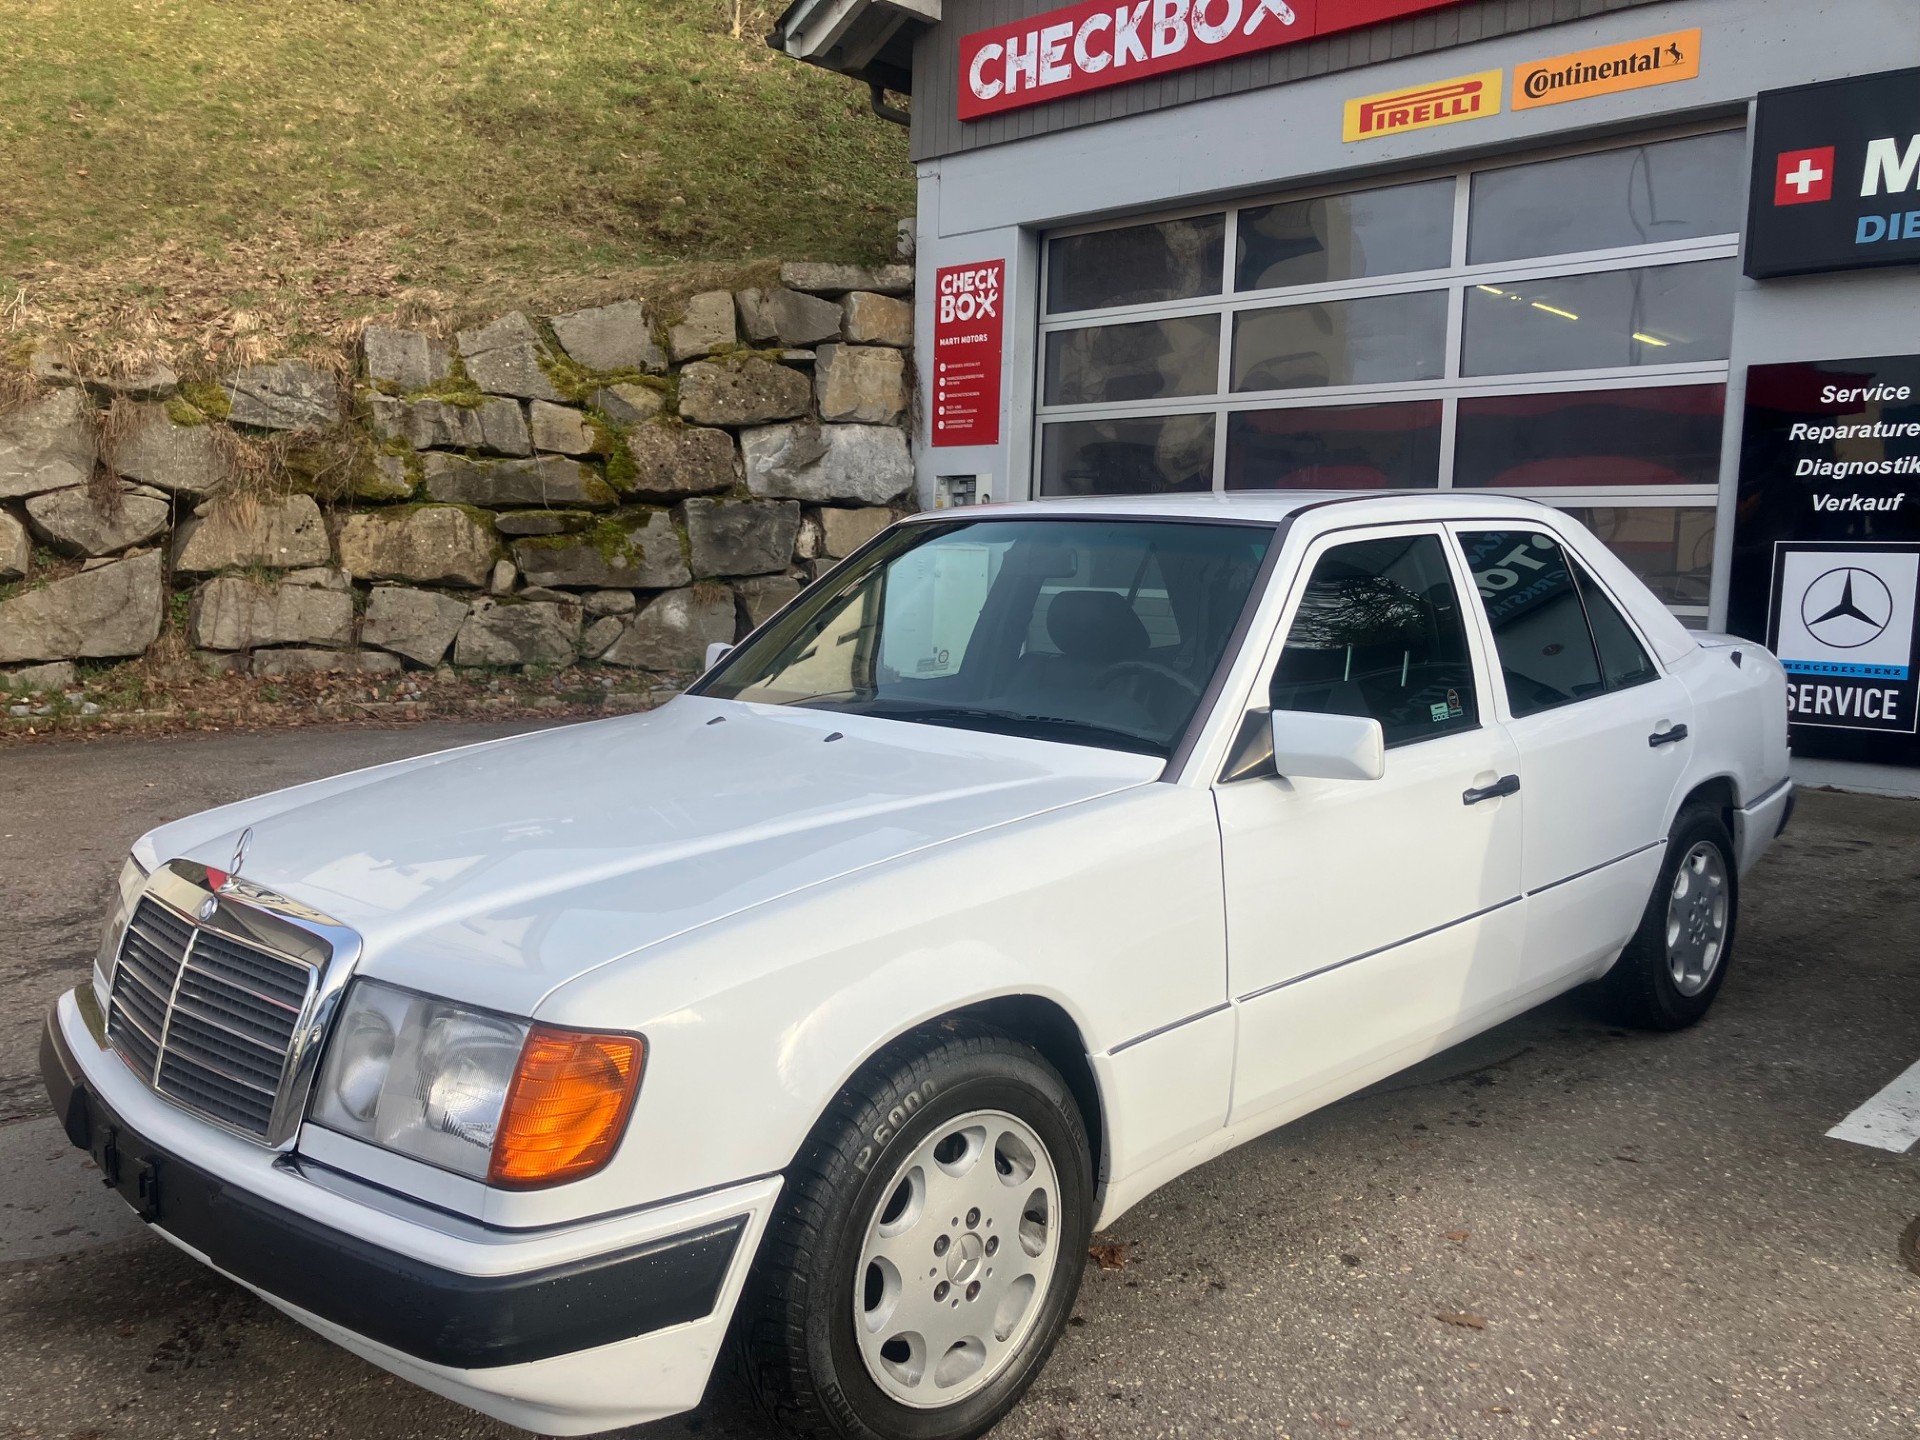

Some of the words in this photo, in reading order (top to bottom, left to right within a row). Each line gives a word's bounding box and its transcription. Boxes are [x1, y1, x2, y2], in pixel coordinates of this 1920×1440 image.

[1523, 47, 1661, 99] Continental
[1359, 80, 1483, 133] PIRELLI
[940, 267, 999, 294] CHECK
[940, 288, 998, 324] BOX
[961, 333, 988, 344] MOTORS
[1820, 383, 1911, 403] Service
[1795, 456, 1920, 480] Diagnostik
[1812, 493, 1906, 512] Verkauf
[1783, 662, 1901, 676] MERCEDES-BENZ
